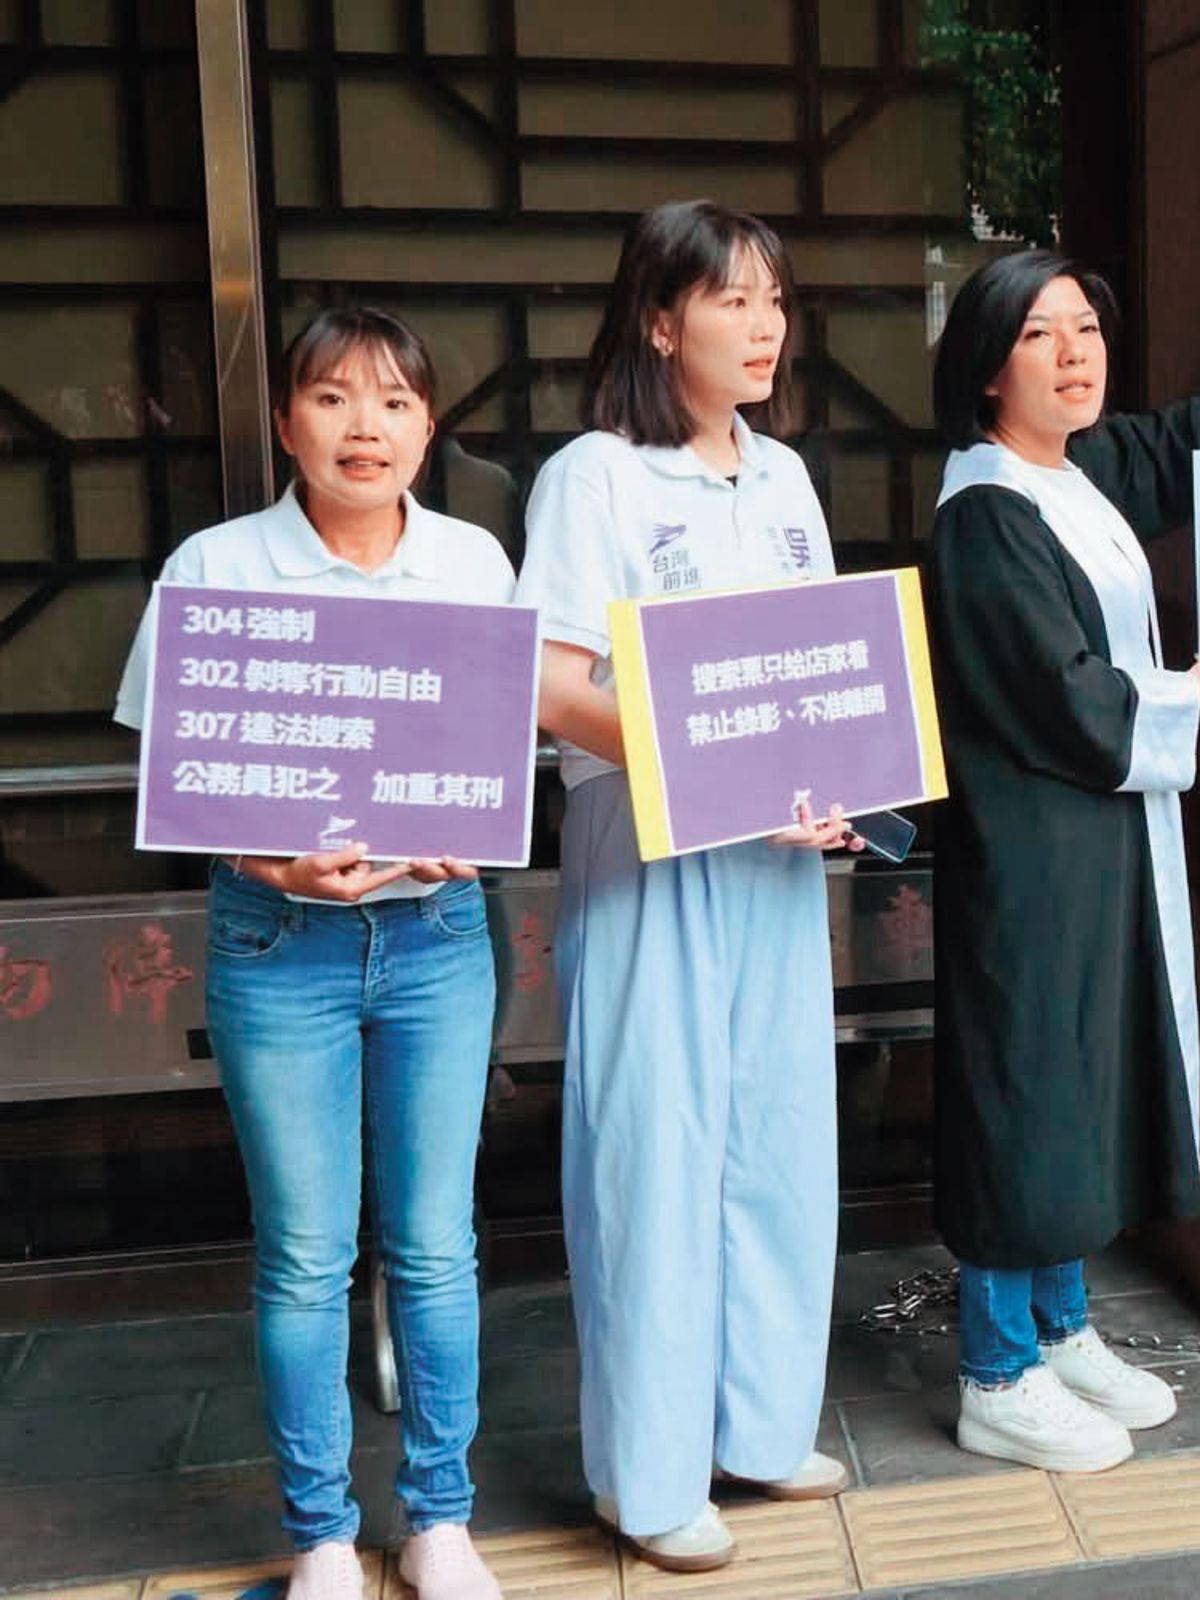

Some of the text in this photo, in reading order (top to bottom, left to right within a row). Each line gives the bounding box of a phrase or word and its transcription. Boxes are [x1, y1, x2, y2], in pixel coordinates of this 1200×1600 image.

[183, 605, 316, 643] 304 強制
[179, 657, 443, 703] 302 剝奪行動自由
[691, 639, 870, 696] 搜索票只給店家看
[175, 710, 375, 750] 307 違法搜索
[686, 683, 888, 747] 禁止錄影、不准離開
[173, 760, 504, 809] 公務員犯之 加重其刑
